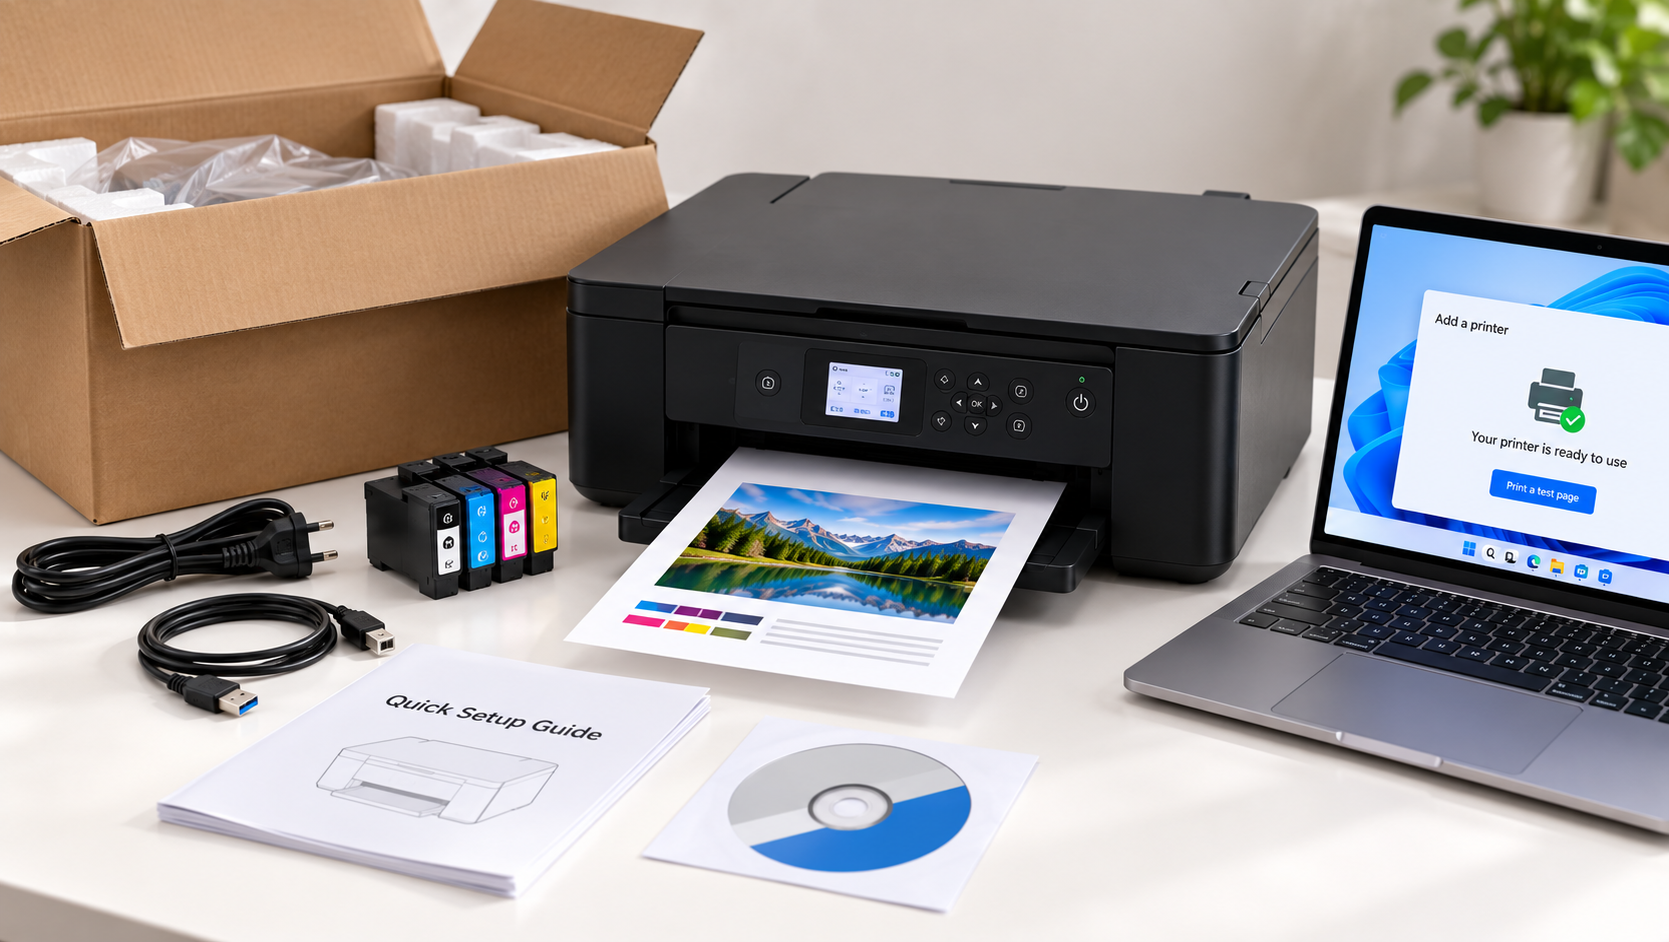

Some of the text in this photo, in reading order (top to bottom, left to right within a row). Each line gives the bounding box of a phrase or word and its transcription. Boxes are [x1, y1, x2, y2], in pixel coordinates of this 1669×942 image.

[1435, 314, 1509, 335] Add a printer
[971, 400, 983, 408] OK
[1471, 430, 1628, 468] Your printer is ready to use
[1506, 481, 1527, 493] Print
[1538, 487, 1554, 498] test
[1556, 491, 1580, 504] page
[385, 694, 603, 741] Quick Setup Guide
